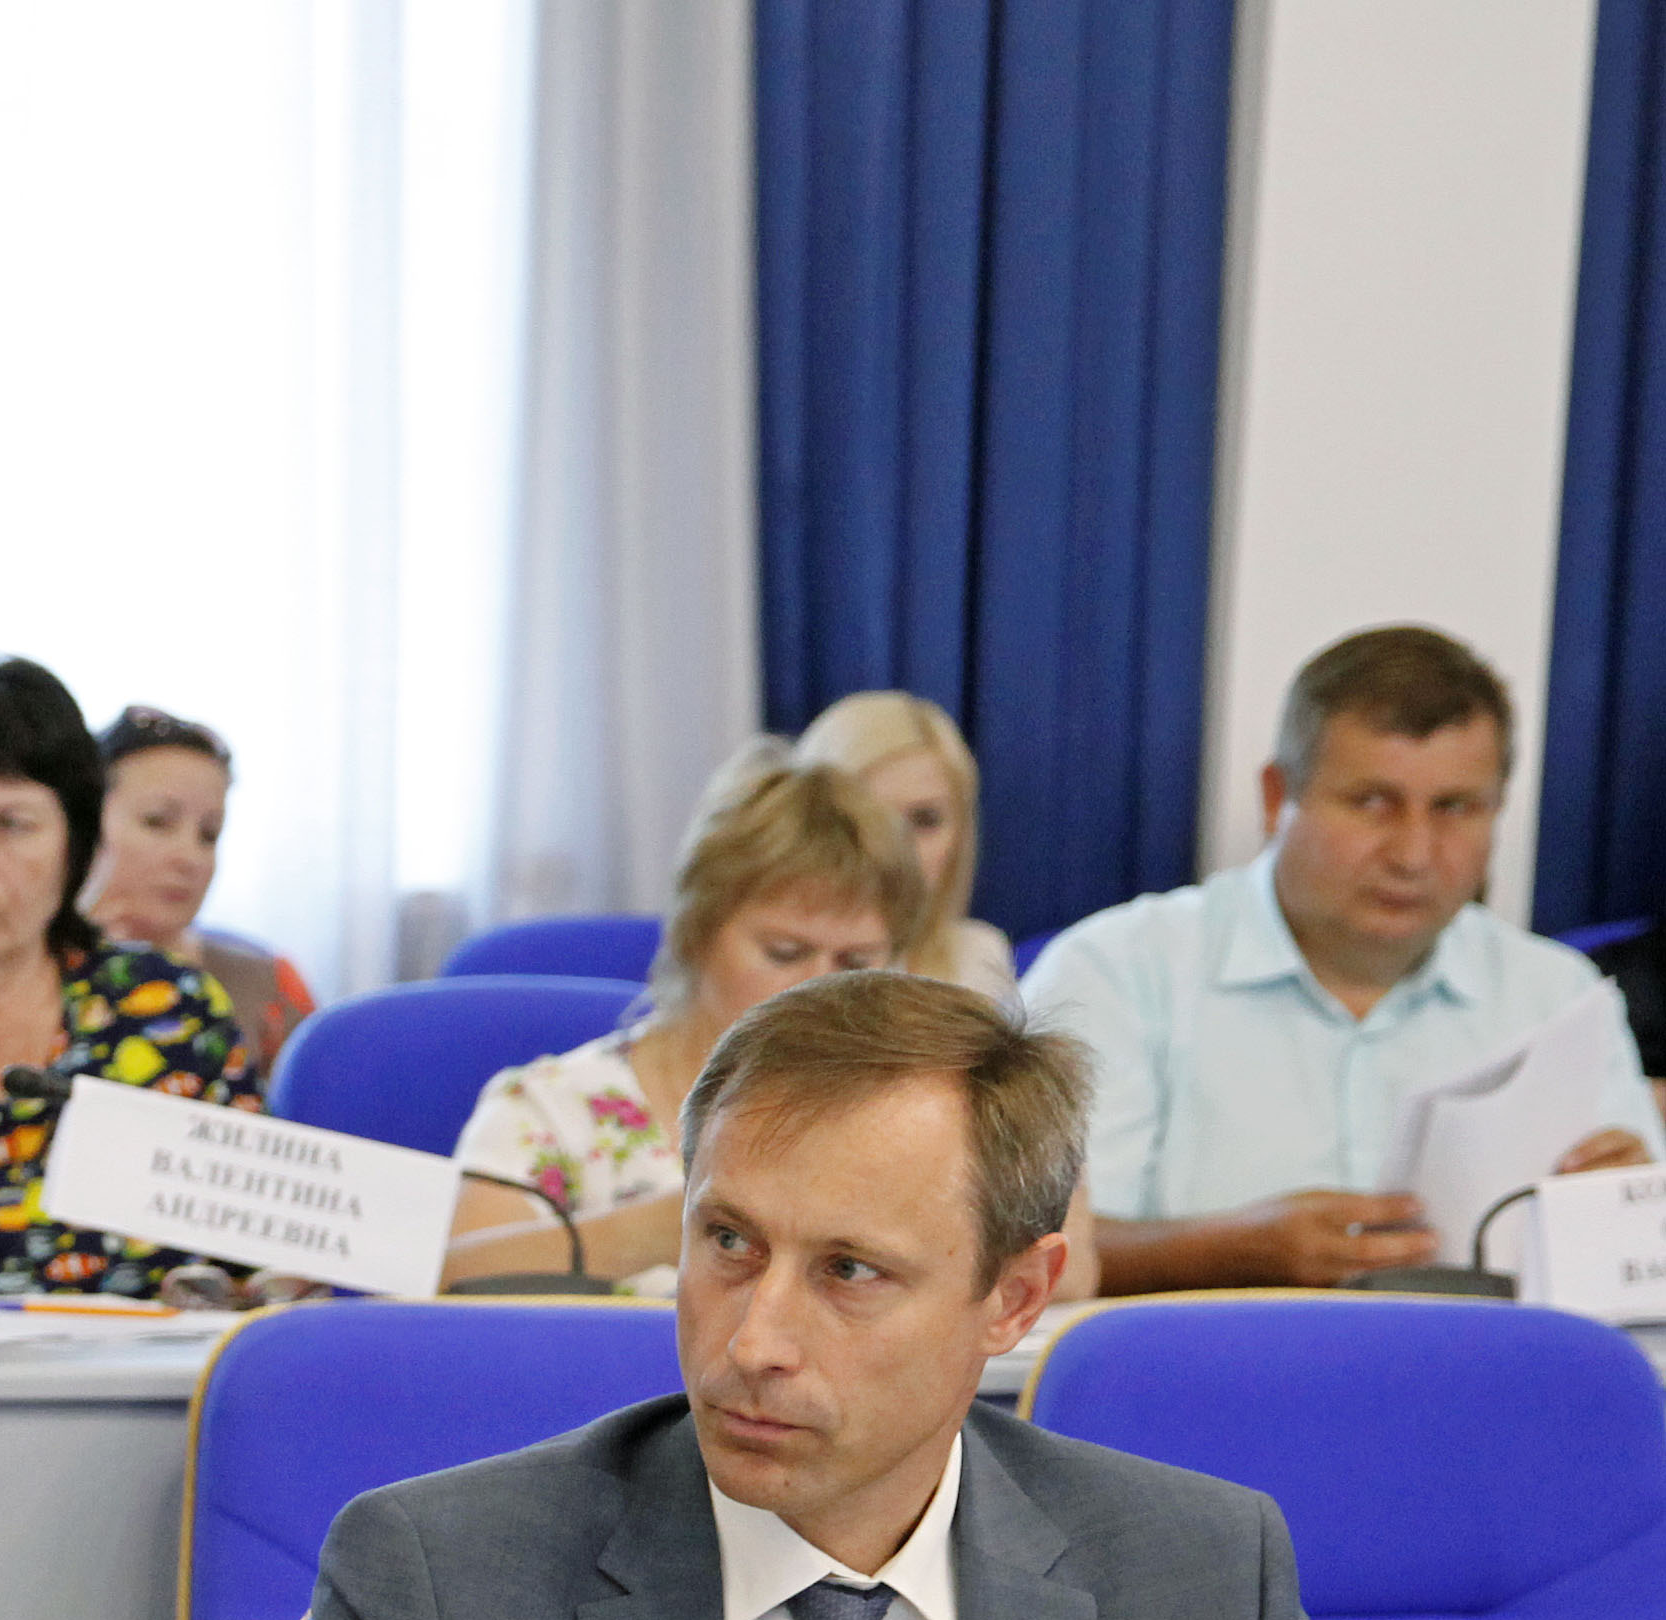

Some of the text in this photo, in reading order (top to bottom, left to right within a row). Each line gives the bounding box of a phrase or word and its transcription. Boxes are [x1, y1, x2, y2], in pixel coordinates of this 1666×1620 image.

[188, 1115, 343, 1172] ЖИЛИНА
[149, 1149, 364, 1218] ВАЛЕНТИНА
[148, 1192, 352, 1258] АНДРЕЕВНА
